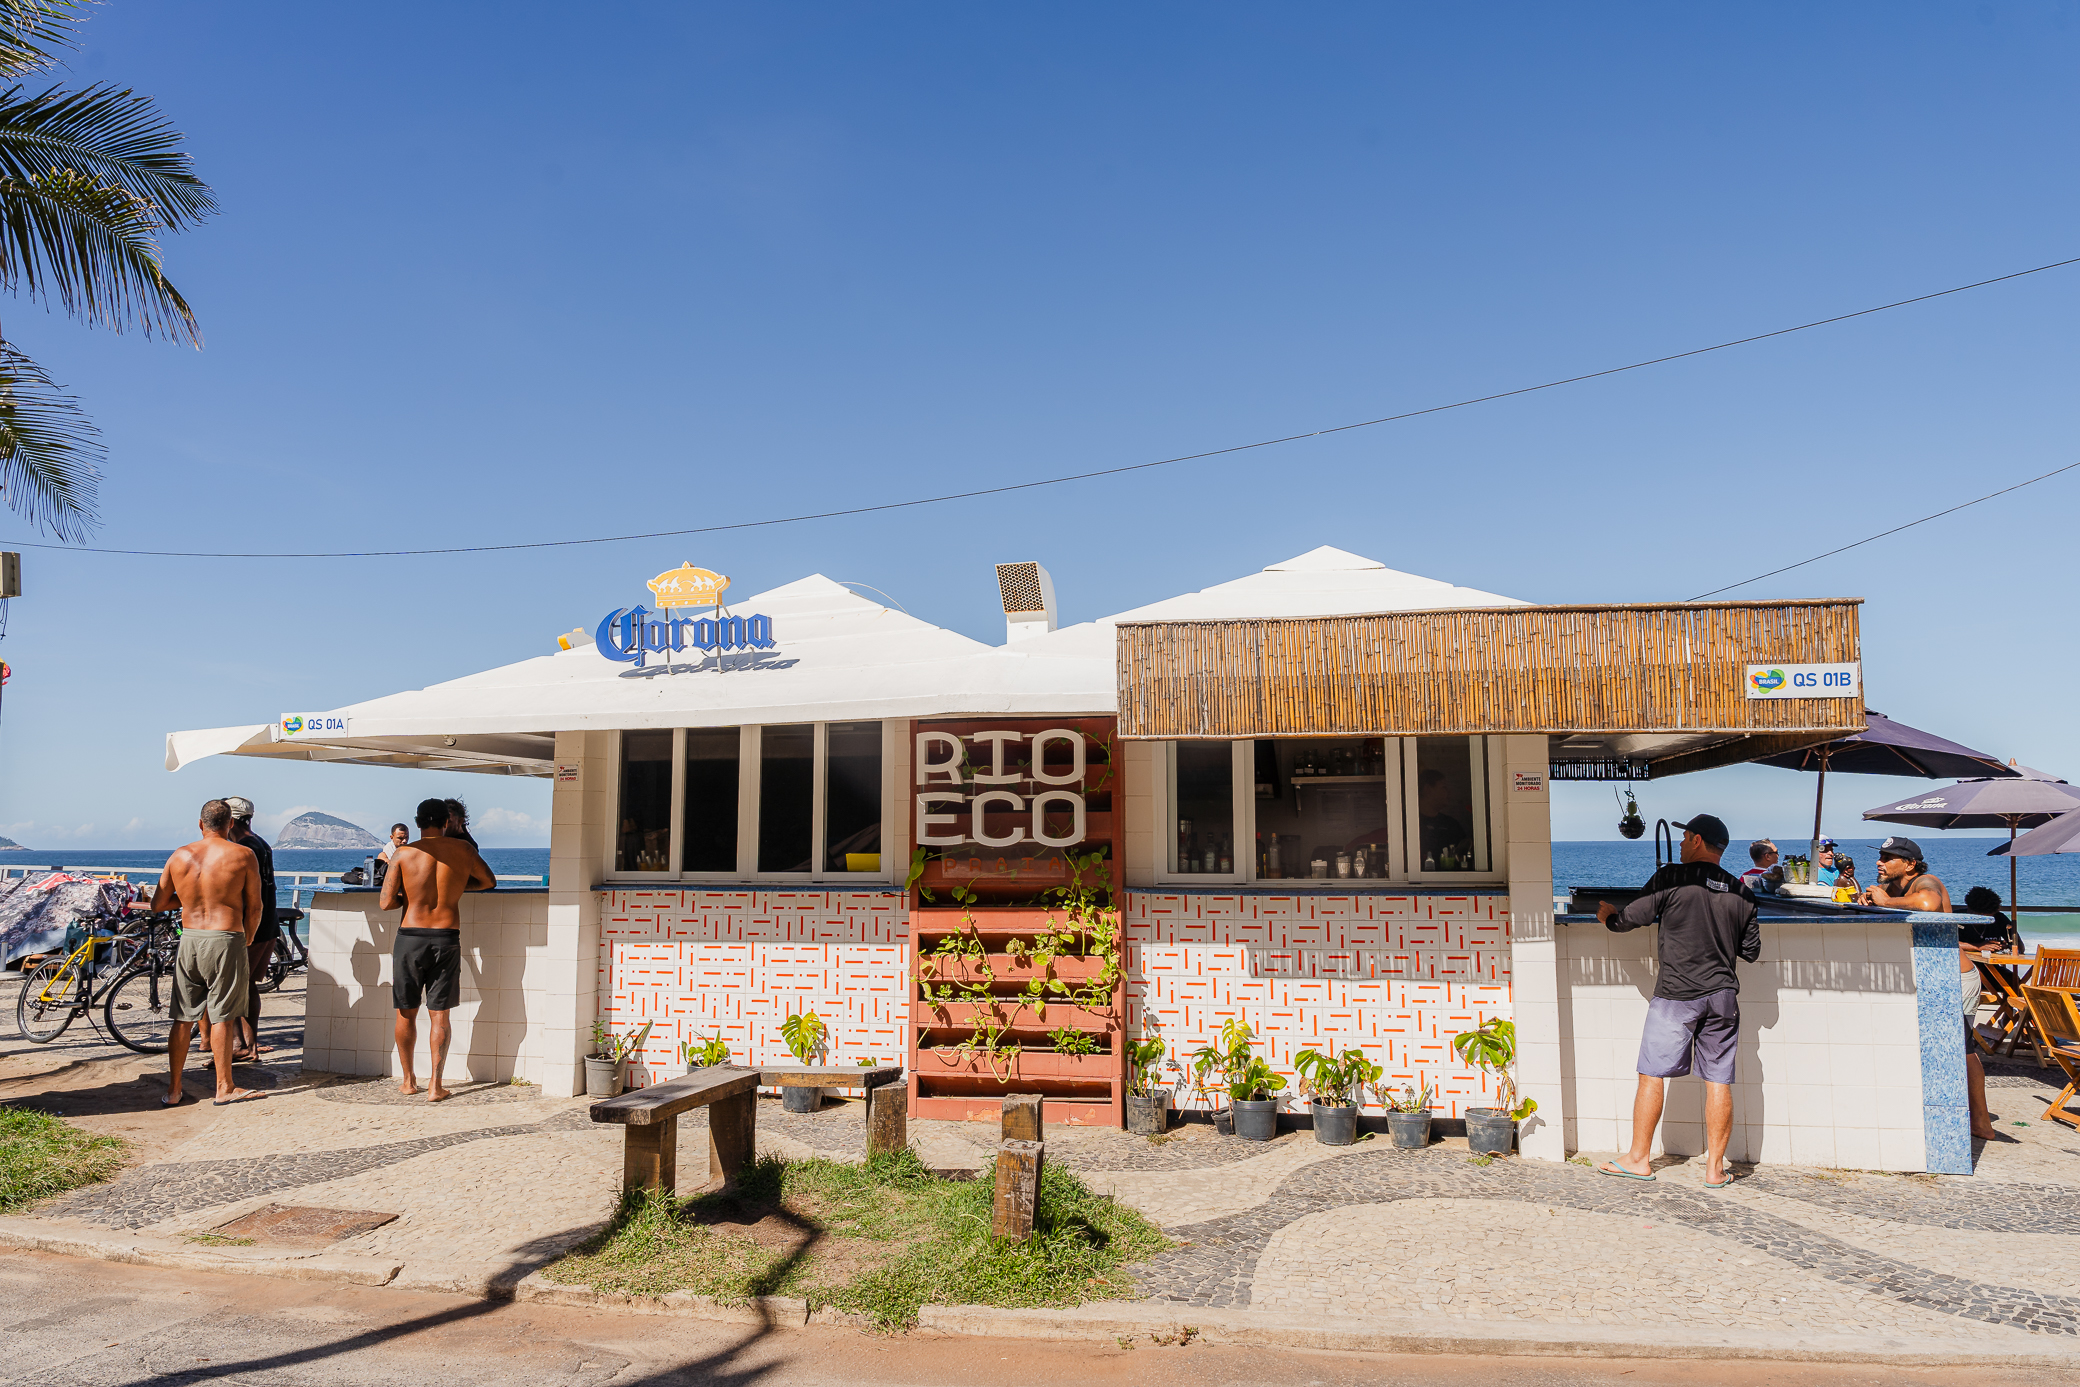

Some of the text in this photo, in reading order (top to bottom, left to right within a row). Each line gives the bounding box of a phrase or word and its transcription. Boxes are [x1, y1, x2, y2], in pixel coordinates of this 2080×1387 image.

[596, 604, 777, 667] Corona
[1793, 672, 1852, 687] QS 01B
[308, 718, 344, 730] QS 01A
[916, 728, 1086, 785] RIO
[916, 790, 1086, 847] ECO
[944, 856, 1062, 872] PRAIA
